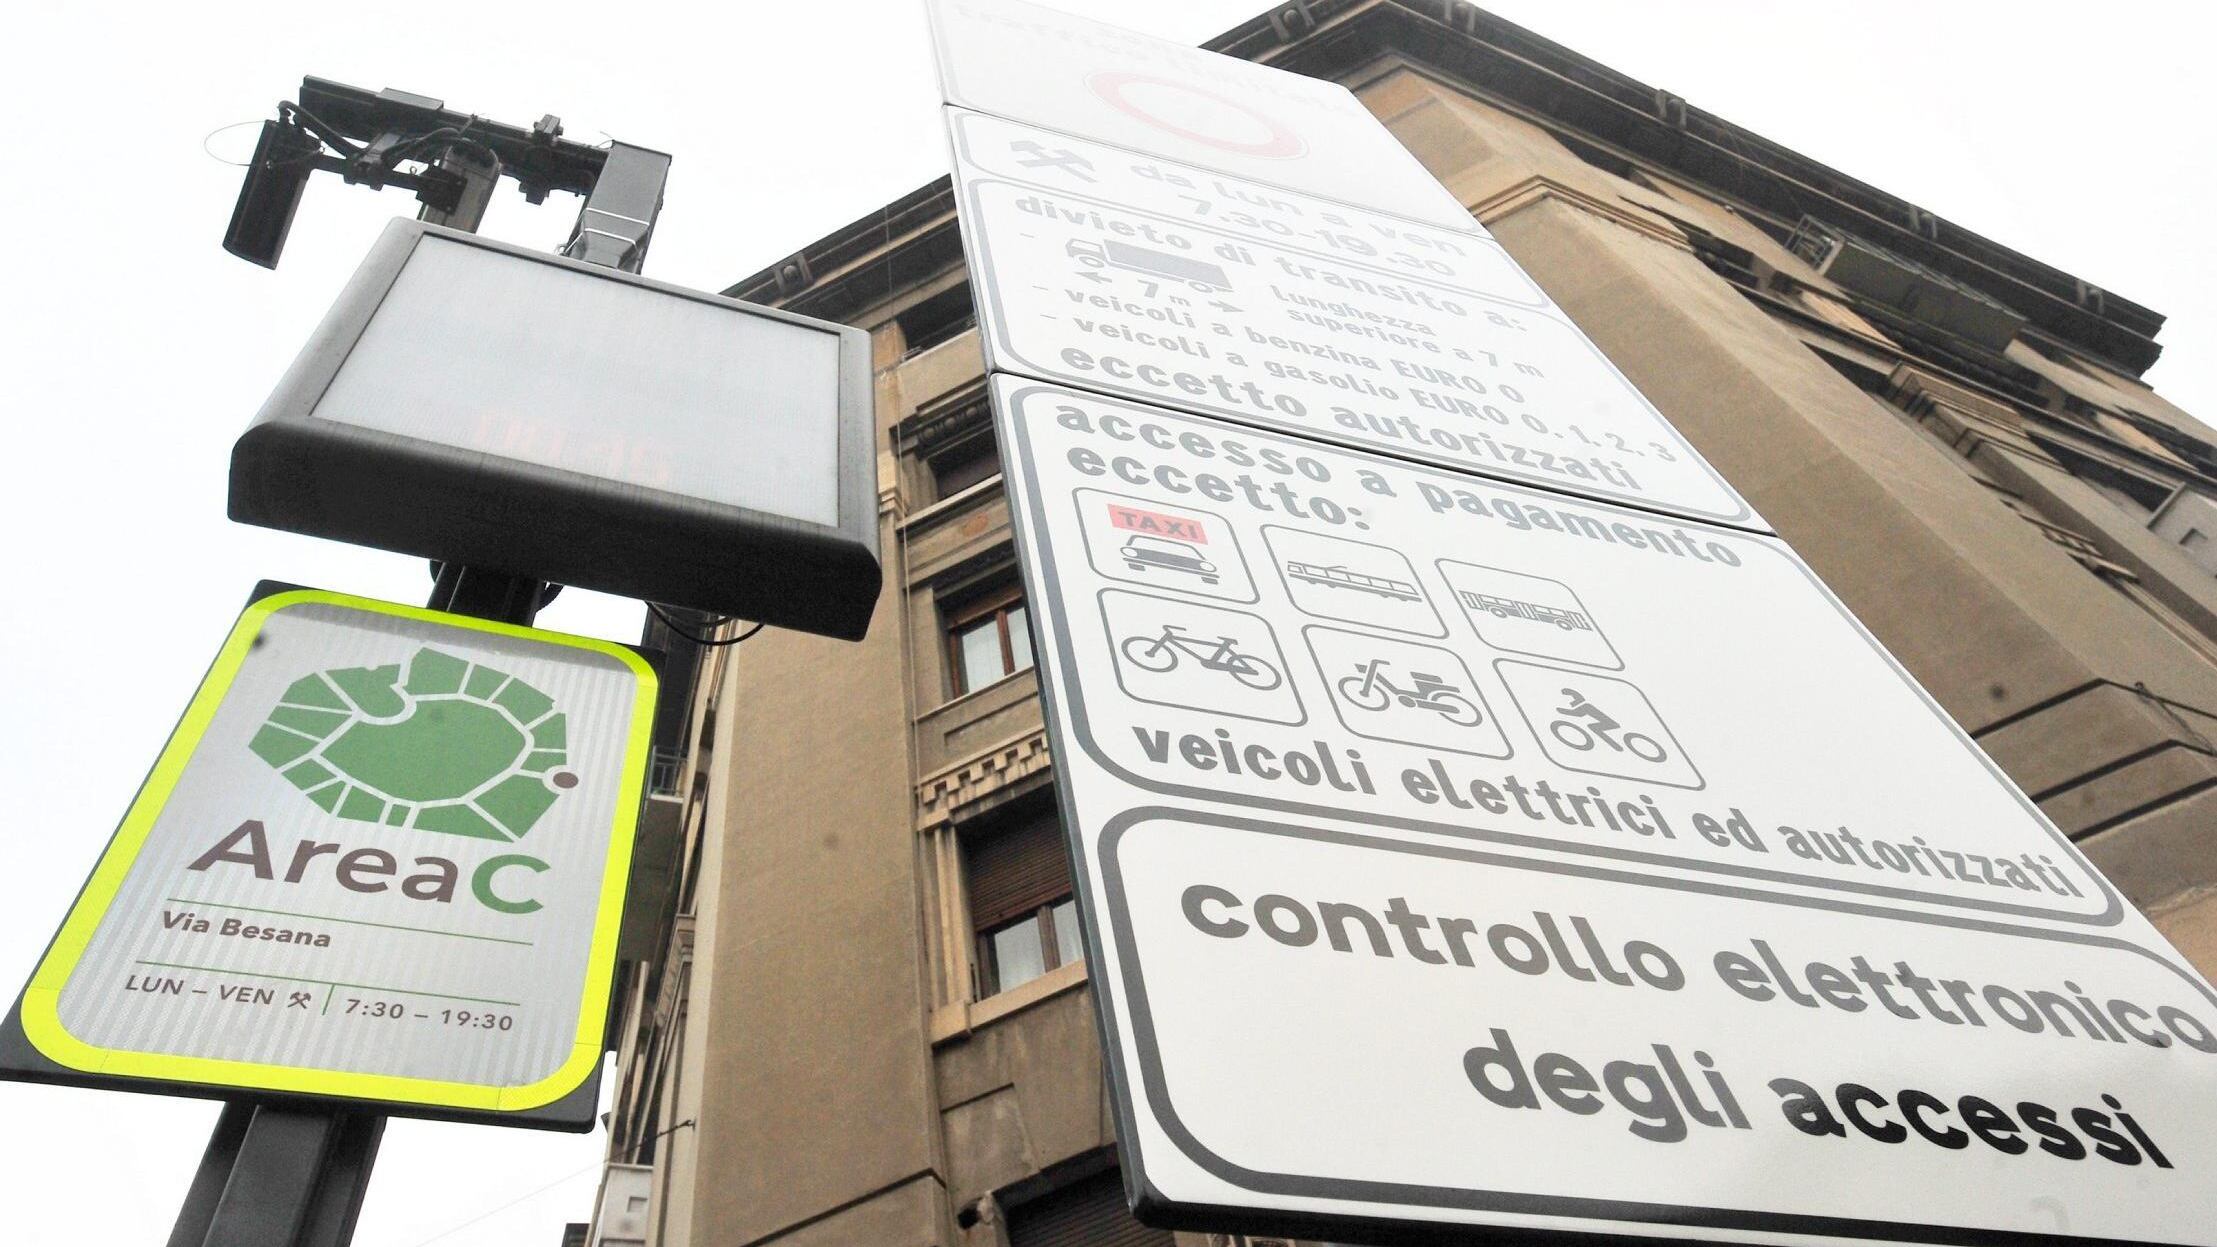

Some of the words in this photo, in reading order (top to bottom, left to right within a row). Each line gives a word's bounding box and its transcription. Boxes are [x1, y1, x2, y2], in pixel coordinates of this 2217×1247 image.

[1015, 196, 1192, 250] divieto
[1214, 242, 1256, 266] di
[1273, 255, 1466, 317] transito
[1486, 311, 1528, 332] a:
[1130, 163, 1196, 190] da
[1320, 212, 1353, 228] a
[1368, 223, 1468, 257] ven
[1064, 288, 1196, 331] veicoli
[1211, 321, 1232, 337] a
[1244, 326, 1381, 371] benzina
[1391, 358, 1487, 395] EURO
[1499, 384, 1526, 403] 0
[1137, 280, 1160, 298] 7
[1169, 295, 1191, 307] m
[1287, 307, 1440, 354] superiore
[1453, 347, 1473, 361] a
[1478, 350, 1498, 367] 7
[1514, 362, 1545, 378] m
[1060, 347, 1308, 417] eccetto
[1330, 402, 1643, 491] autorizzati
[1073, 315, 1210, 359] veicoli
[1226, 351, 1248, 368] a
[1263, 359, 1399, 400] gasolio
[1408, 388, 1509, 426] EURO
[1056, 406, 1332, 482] accesso
[1356, 468, 1397, 497] a
[1415, 481, 1742, 567] pagamento
[1067, 447, 1370, 530] eccetto:
[1118, 511, 1199, 539] TAXI
[1132, 726, 1377, 795] veicoli
[1401, 759, 1676, 839] elettrici
[1692, 808, 1769, 854] ed
[1777, 826, 2085, 898] autorizzati
[162, 911, 210, 934] Via
[219, 917, 331, 948] Besana
[1181, 884, 1686, 992] controllo
[1713, 938, 2217, 1054] elettronico
[125, 974, 184, 995] LUN
[220, 985, 274, 1005] VEN
[346, 999, 403, 1019] 7:30
[440, 1008, 513, 1031] 19:30
[1463, 1027, 1753, 1143] degli
[1768, 1077, 2175, 1169] accessi
